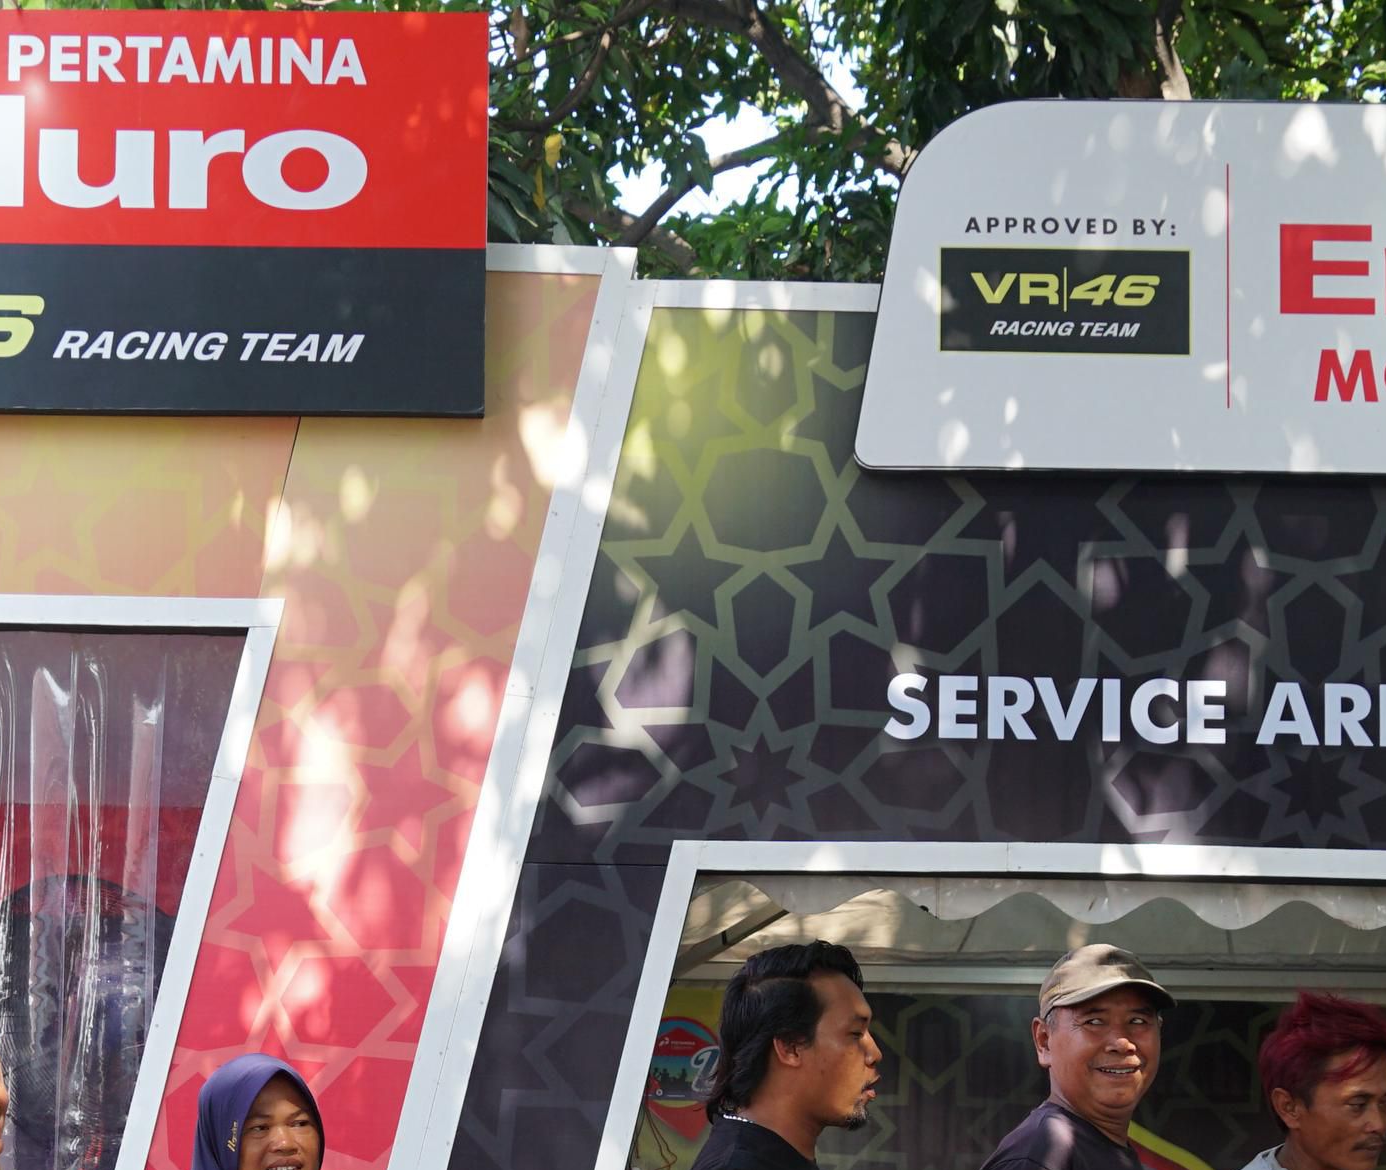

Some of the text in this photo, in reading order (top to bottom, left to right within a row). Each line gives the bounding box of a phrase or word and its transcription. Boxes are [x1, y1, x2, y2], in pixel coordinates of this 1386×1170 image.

[7, 33, 368, 87] PERTAMINA
[964, 216, 1177, 237] APPROVED BY:
[52, 328, 229, 363] RACING
[239, 333, 365, 365] TEAM
[989, 320, 1141, 339] RACING TEAM
[882, 672, 1228, 747] SERVICE
